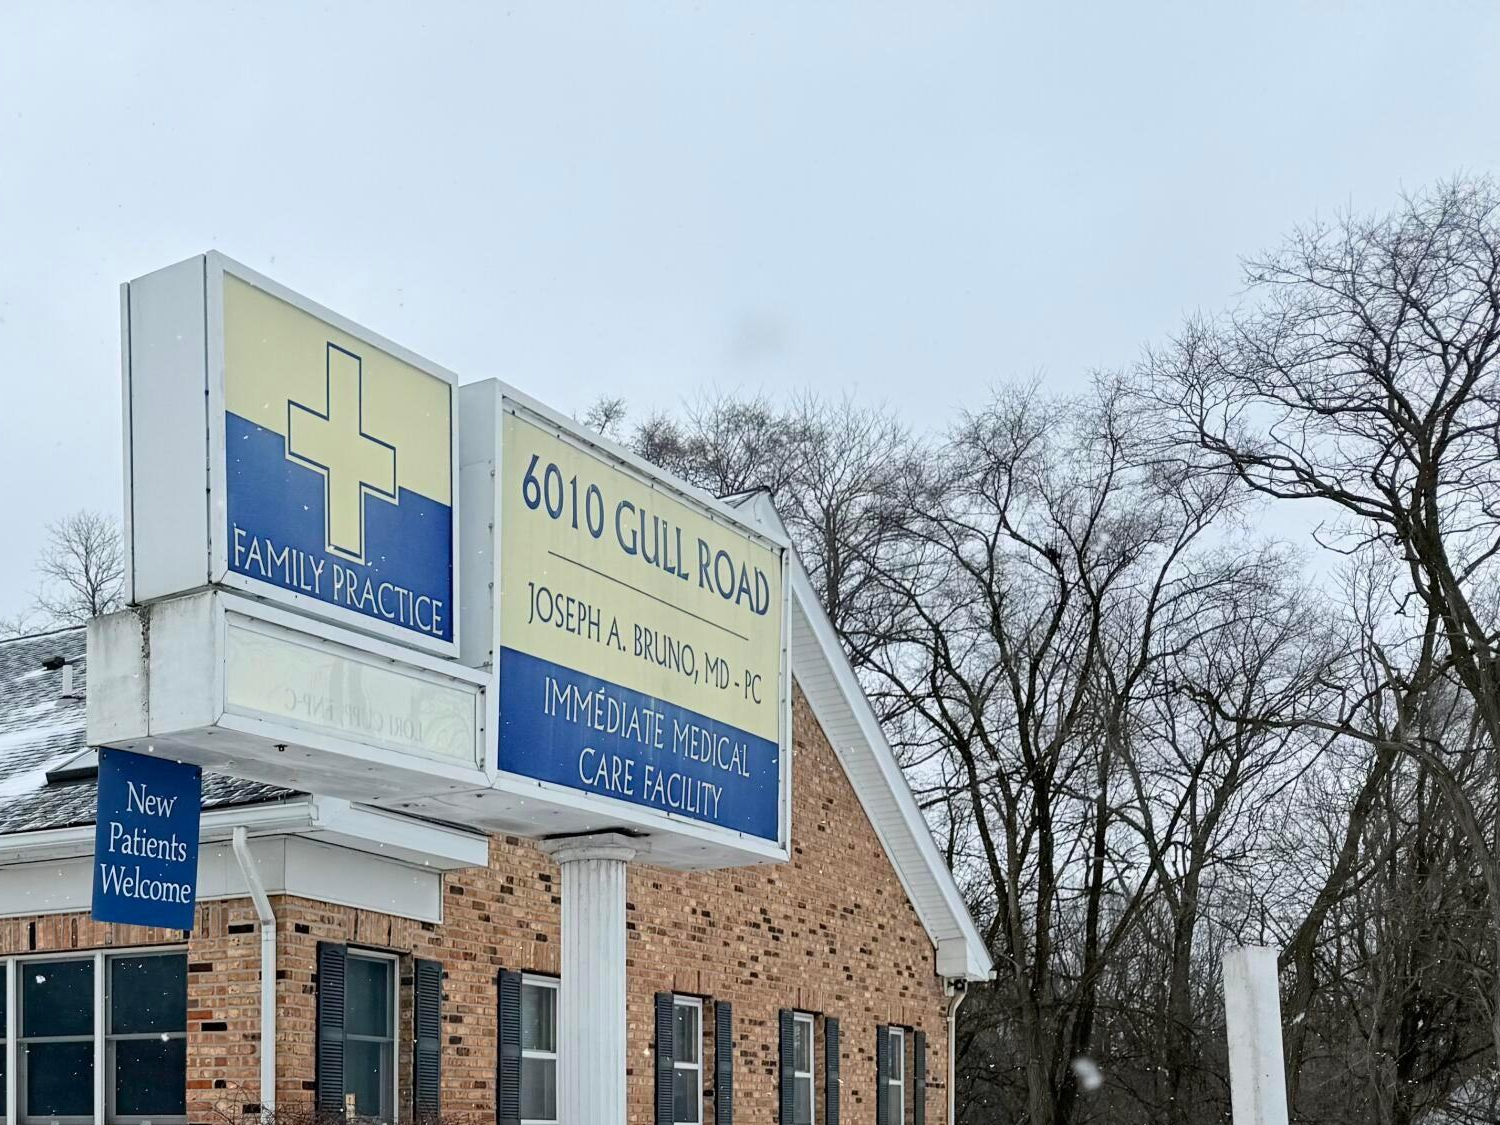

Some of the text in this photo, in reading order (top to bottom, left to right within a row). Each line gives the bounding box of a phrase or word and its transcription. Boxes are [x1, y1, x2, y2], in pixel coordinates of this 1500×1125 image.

[522, 453, 770, 616] 6010 GULL ROAD
[233, 526, 444, 636] FAMILY PRACTICE
[528, 582, 601, 643] JOSEPH
[606, 616, 626, 652] A.
[634, 623, 699, 685] BRUNO,
[704, 652, 730, 690] MD
[744, 669, 762, 705] PC
[544, 676, 750, 778] IMMEDIATE MEDICAL
[126, 781, 176, 818] New
[578, 747, 723, 819] CARE FACILITY
[100, 863, 192, 904] Welcome
[108, 821, 187, 862] Patients
